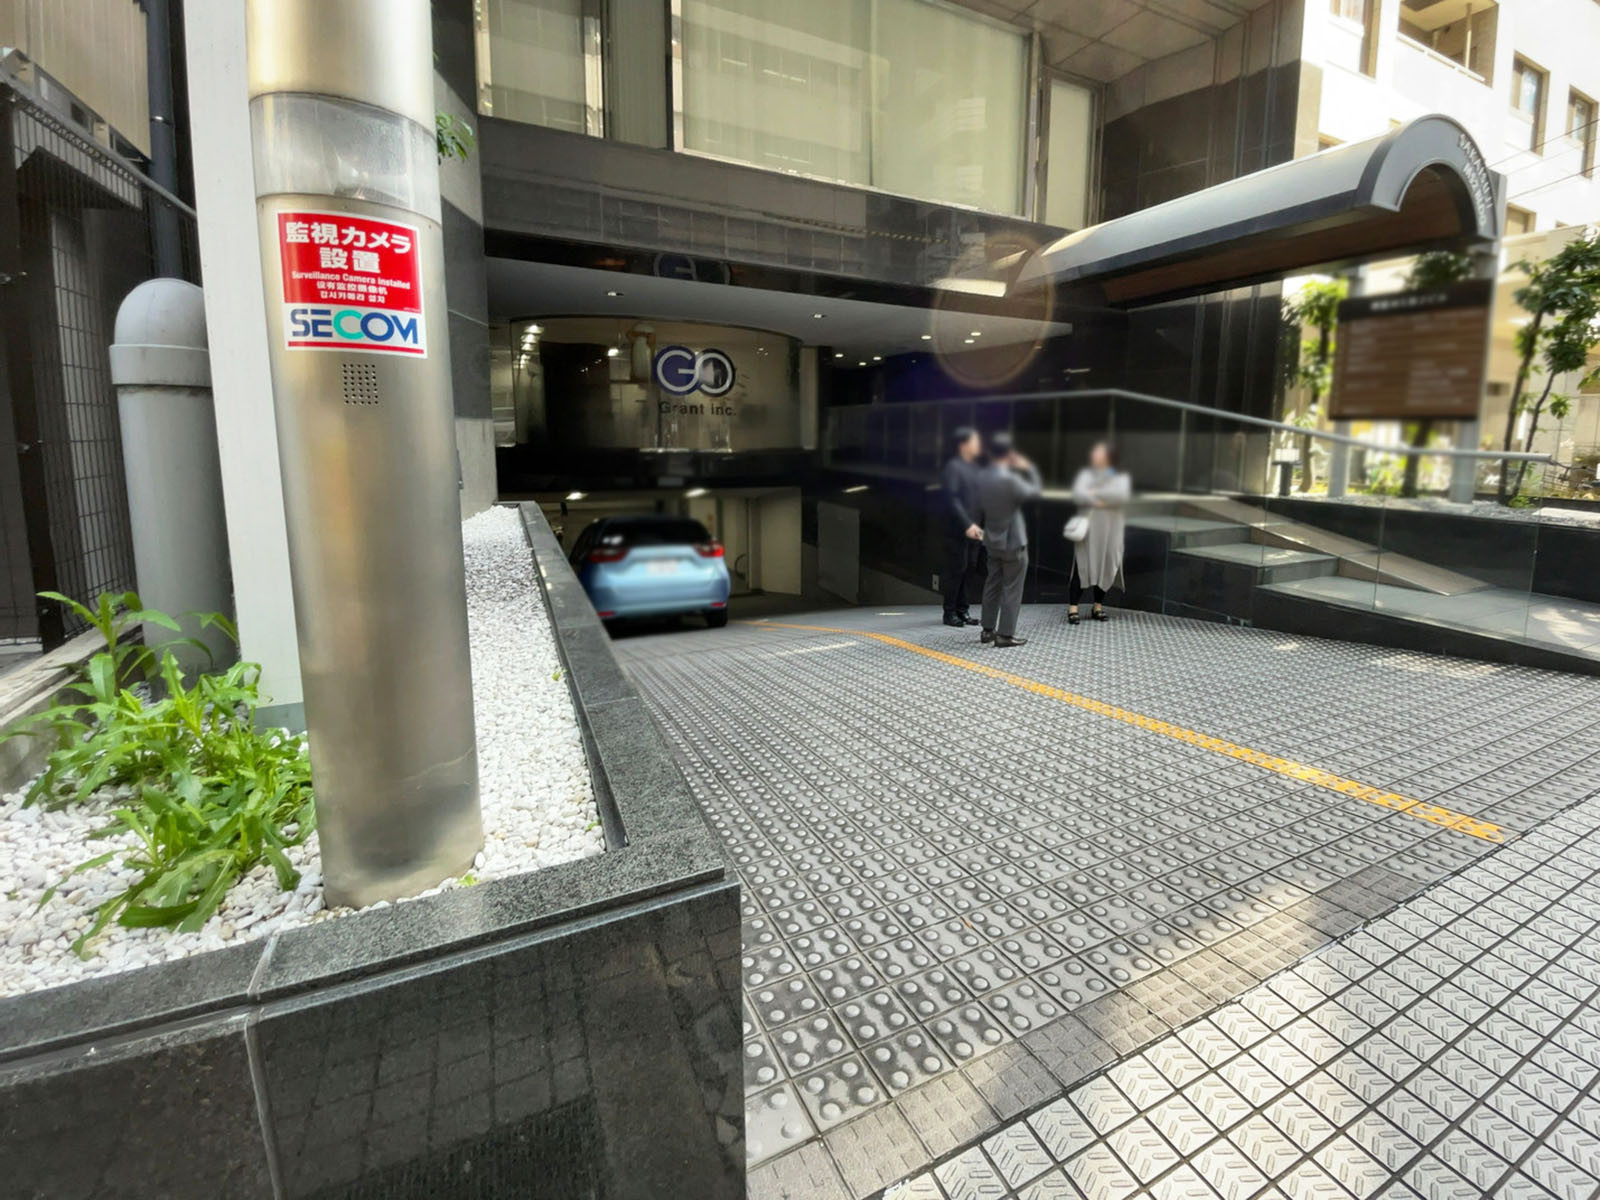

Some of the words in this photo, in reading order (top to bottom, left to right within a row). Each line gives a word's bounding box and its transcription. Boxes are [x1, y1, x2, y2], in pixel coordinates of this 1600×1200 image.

[285, 221, 412, 254] 監視カメラ
[319, 247, 381, 273] 設置
[291, 271, 340, 281] Surveillance
[342, 273, 376, 284] Camera
[290, 308, 418, 345] SECOM
[658, 400, 704, 415] Grant
